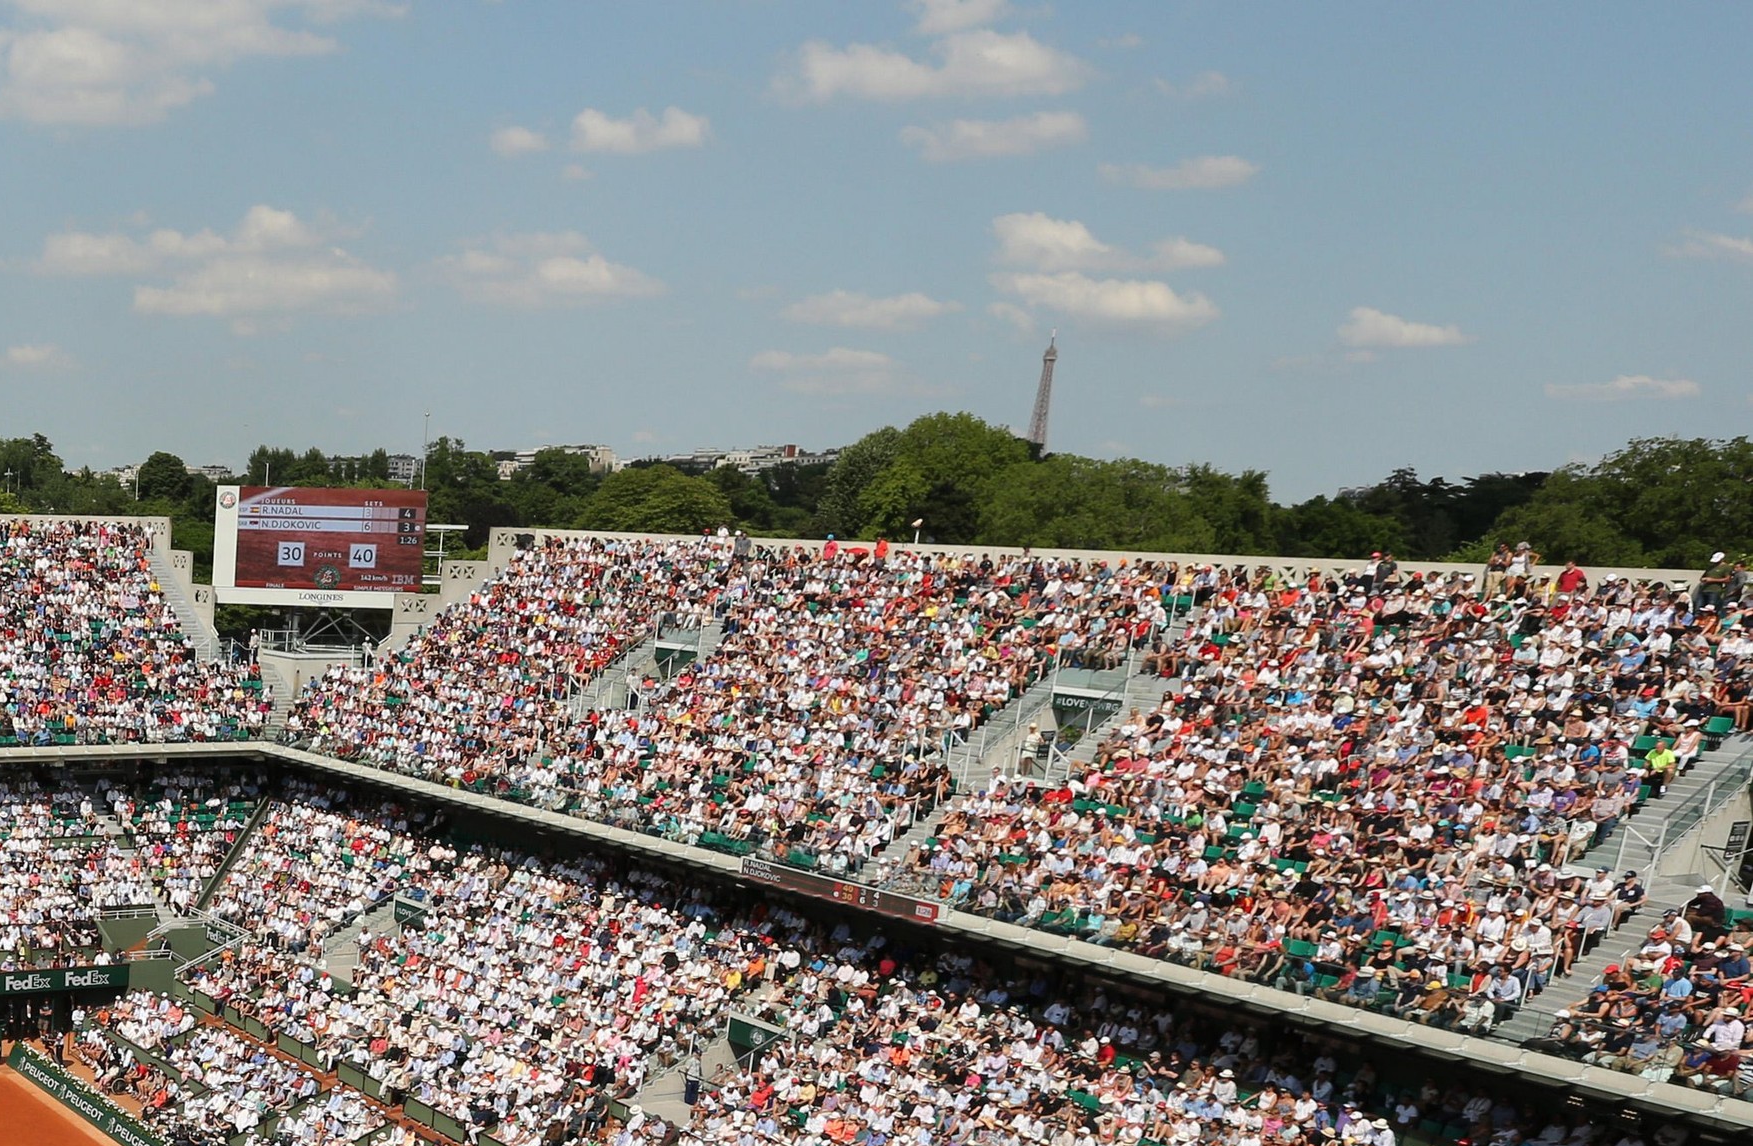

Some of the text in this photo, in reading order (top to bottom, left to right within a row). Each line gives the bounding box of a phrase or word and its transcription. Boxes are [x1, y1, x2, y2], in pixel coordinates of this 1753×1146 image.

[262, 506, 303, 516] R.NADAL
[404, 509, 411, 518] 4
[261, 520, 410, 532] N.DJOKOVIC 6 3
[400, 536, 418, 545] 1:26
[281, 546, 373, 563] 30 POINTS 40
[392, 575, 415, 585] IBM
[298, 592, 344, 602] LONGINES
[873, 891, 880, 900] 4
[859, 896, 866, 905] 6
[872, 898, 879, 908] 3
[5, 973, 51, 992] FedEx
[65, 969, 110, 987] FedEx
[24, 1062, 60, 1091] PEUGEOT
[65, 1090, 105, 1122] PEUGEOT
